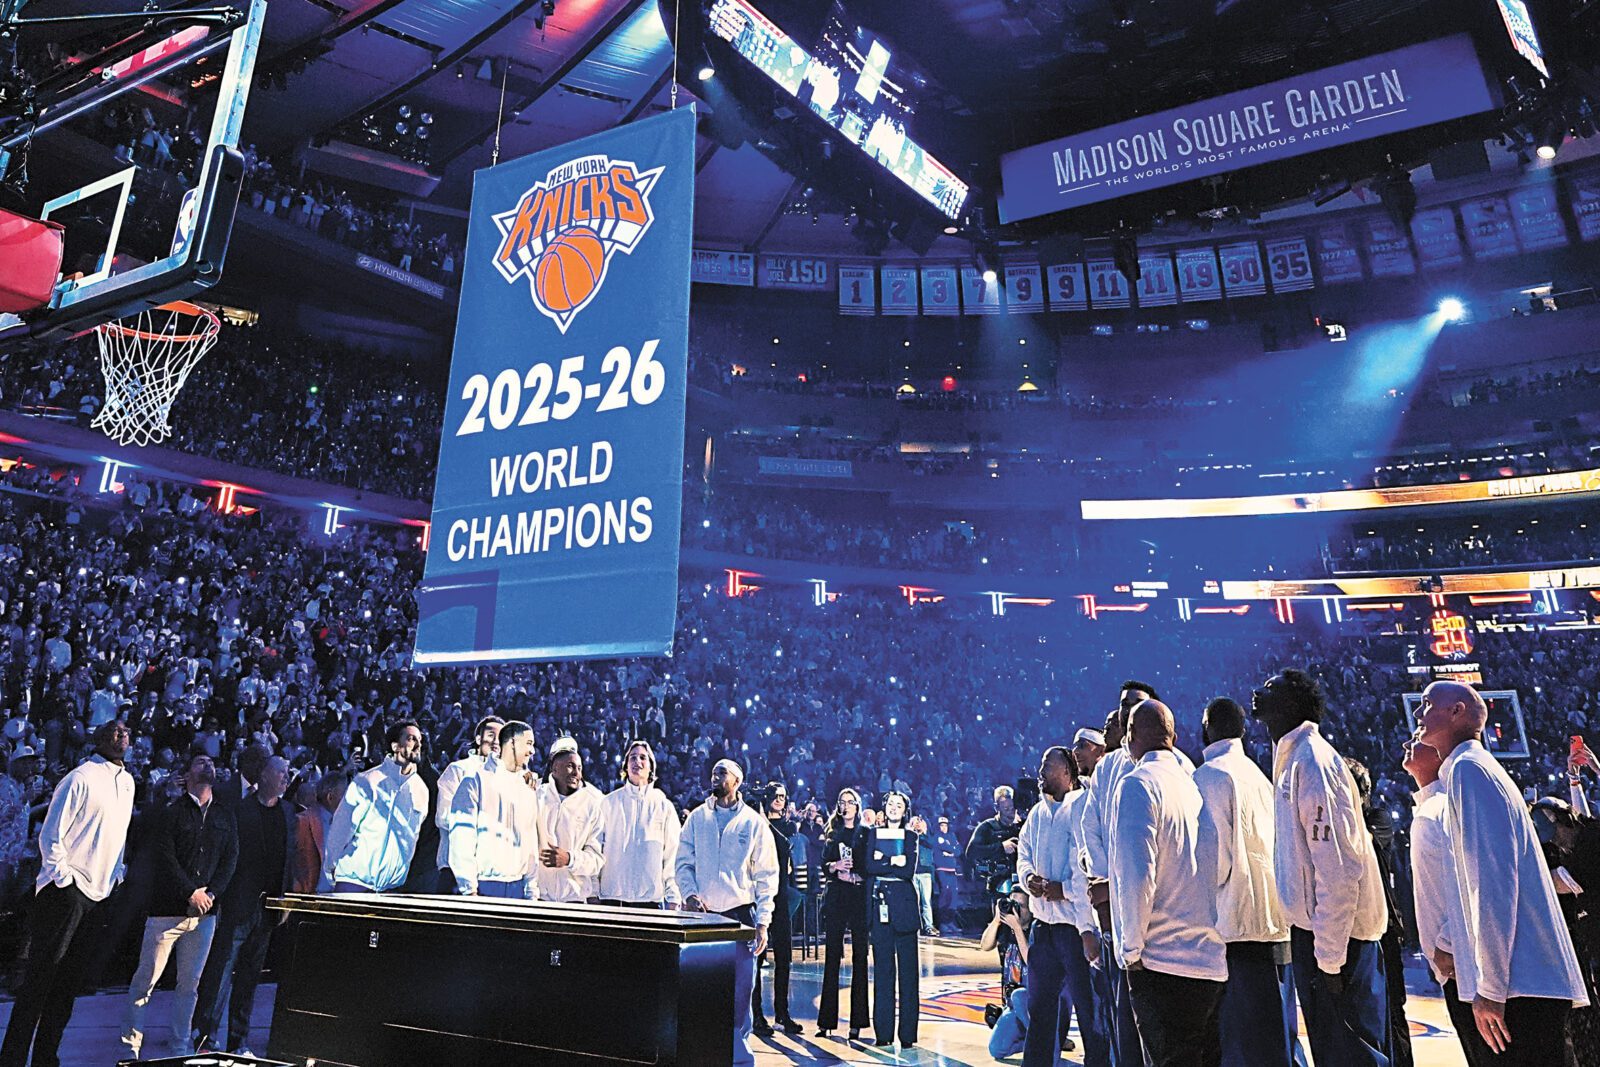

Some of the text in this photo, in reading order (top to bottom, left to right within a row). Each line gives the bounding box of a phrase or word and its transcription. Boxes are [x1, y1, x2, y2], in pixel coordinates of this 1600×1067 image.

[1052, 68, 1405, 186] MADISON SQUARE GARDEN
[1105, 122, 1351, 187] THE WORLD'S MOST FAMOUS ARENA
[548, 159, 607, 188] NEW YORK
[500, 167, 647, 262] KNICKS
[788, 259, 828, 284] 150
[1183, 261, 1214, 289] 19
[1225, 257, 1260, 284] 30
[1271, 251, 1309, 280] 35
[851, 280, 862, 304] 1
[891, 280, 907, 304] 2
[932, 280, 948, 304] 3
[972, 279, 987, 303] 7
[1016, 277, 1032, 302] 9
[1058, 274, 1075, 299] 9
[1096, 272, 1121, 297] 11
[1143, 268, 1168, 294] 11
[455, 338, 666, 437] 2025-26
[490, 440, 614, 498] WORLD
[447, 496, 653, 562] CHAMPIONS
[1433, 631, 1470, 657] 24
[1315, 805, 1323, 822] 1
